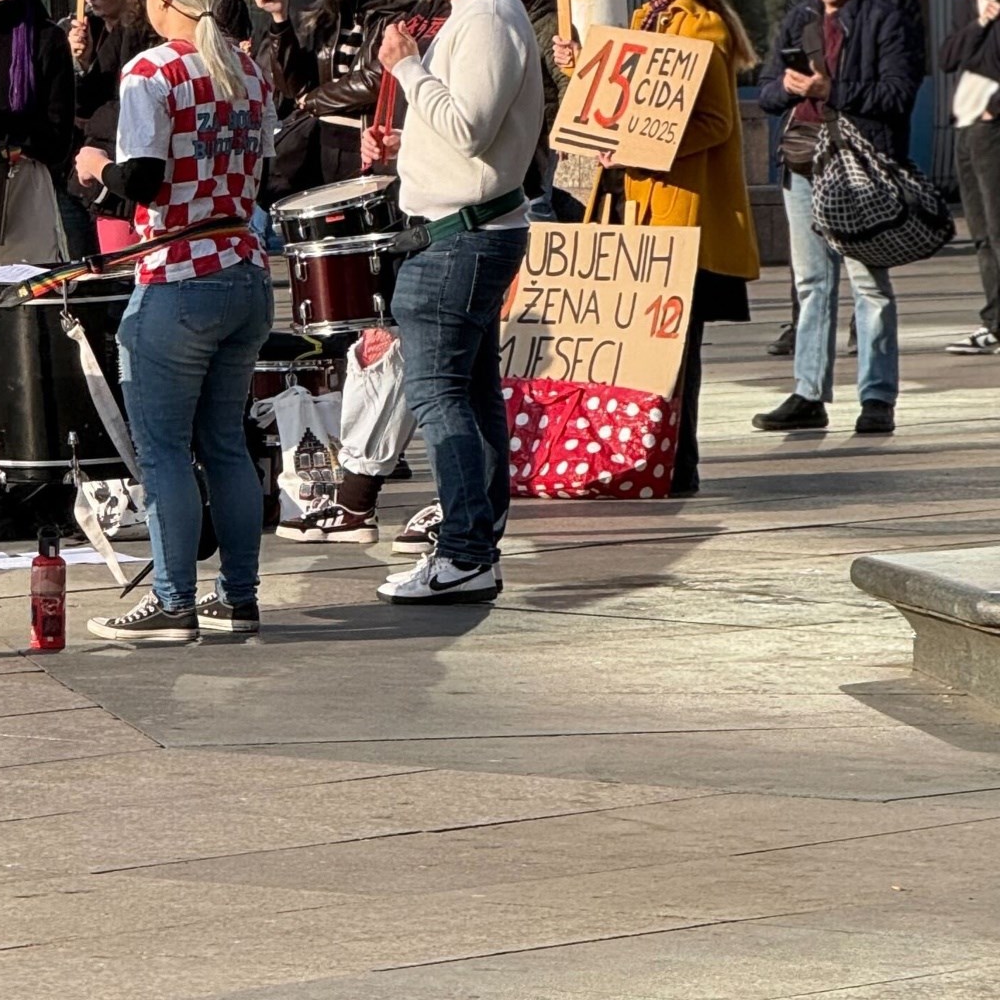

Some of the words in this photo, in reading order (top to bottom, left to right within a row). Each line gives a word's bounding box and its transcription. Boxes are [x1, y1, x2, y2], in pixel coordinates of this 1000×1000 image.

[646, 47, 699, 82] FEMI
[634, 78, 684, 112] CIDA
[627, 115, 640, 134] U
[639, 117, 678, 145] 2025.
[526, 231, 675, 287] UBIJENIH
[517, 280, 600, 325] ŽENA
[614, 292, 638, 329] U
